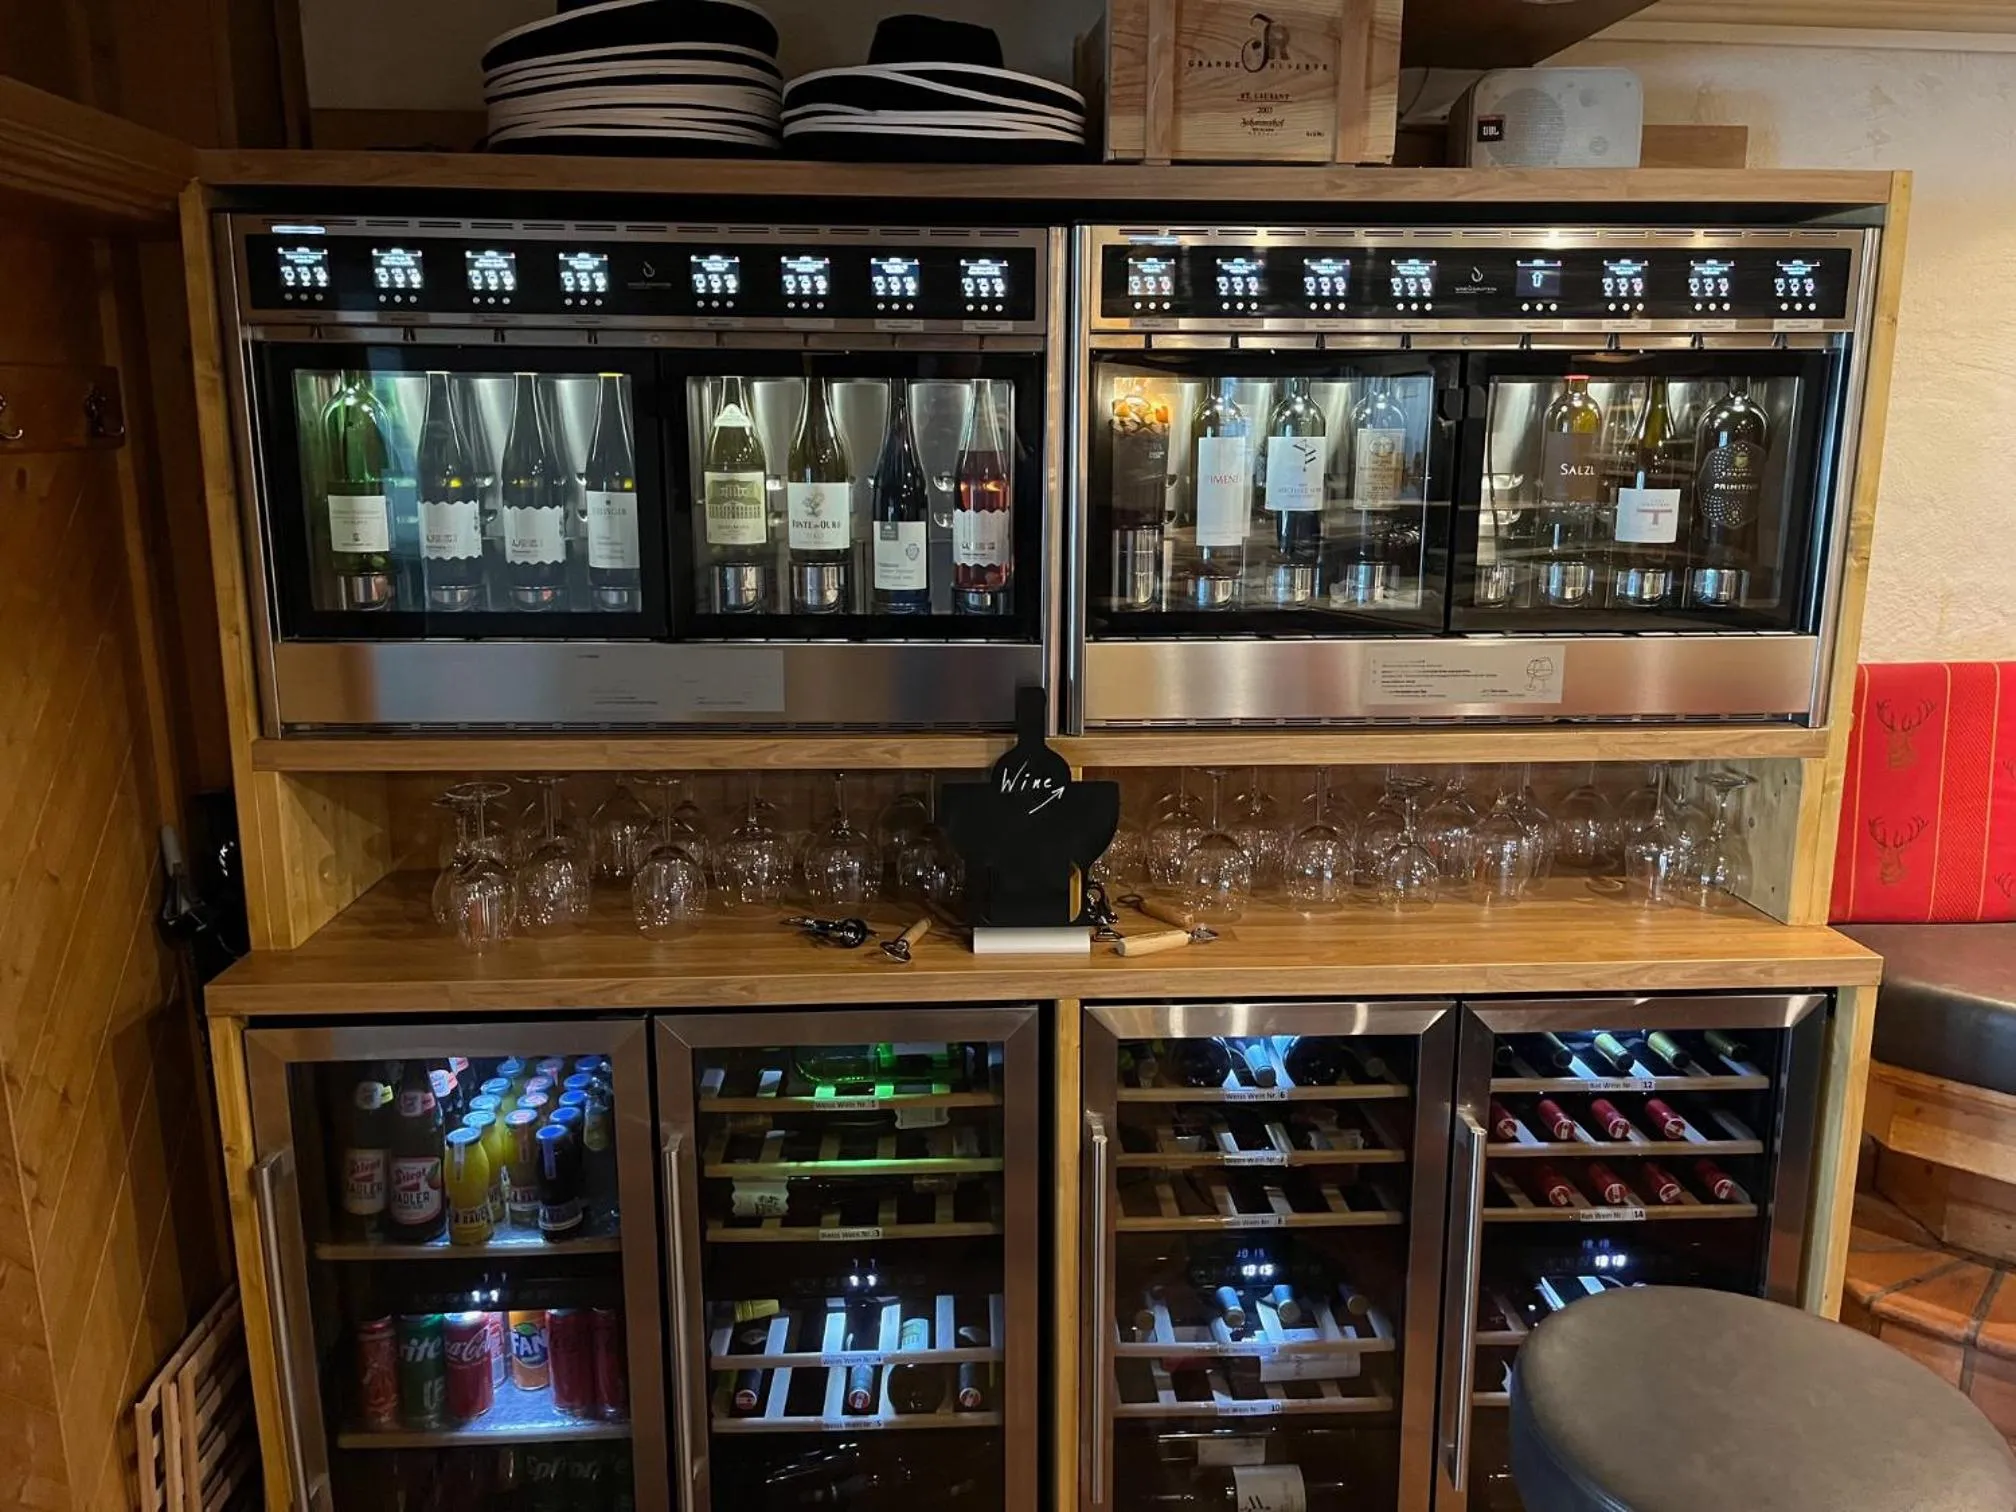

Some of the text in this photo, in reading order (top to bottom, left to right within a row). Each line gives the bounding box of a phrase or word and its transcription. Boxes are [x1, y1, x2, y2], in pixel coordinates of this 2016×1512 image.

[1187, 60, 1240, 68] GRANDE
[1000, 760, 1053, 794] Wine
[1644, 1081, 1653, 1089] 12
[511, 1328, 549, 1356] FAN
[1271, 1404, 1280, 1412] 10
